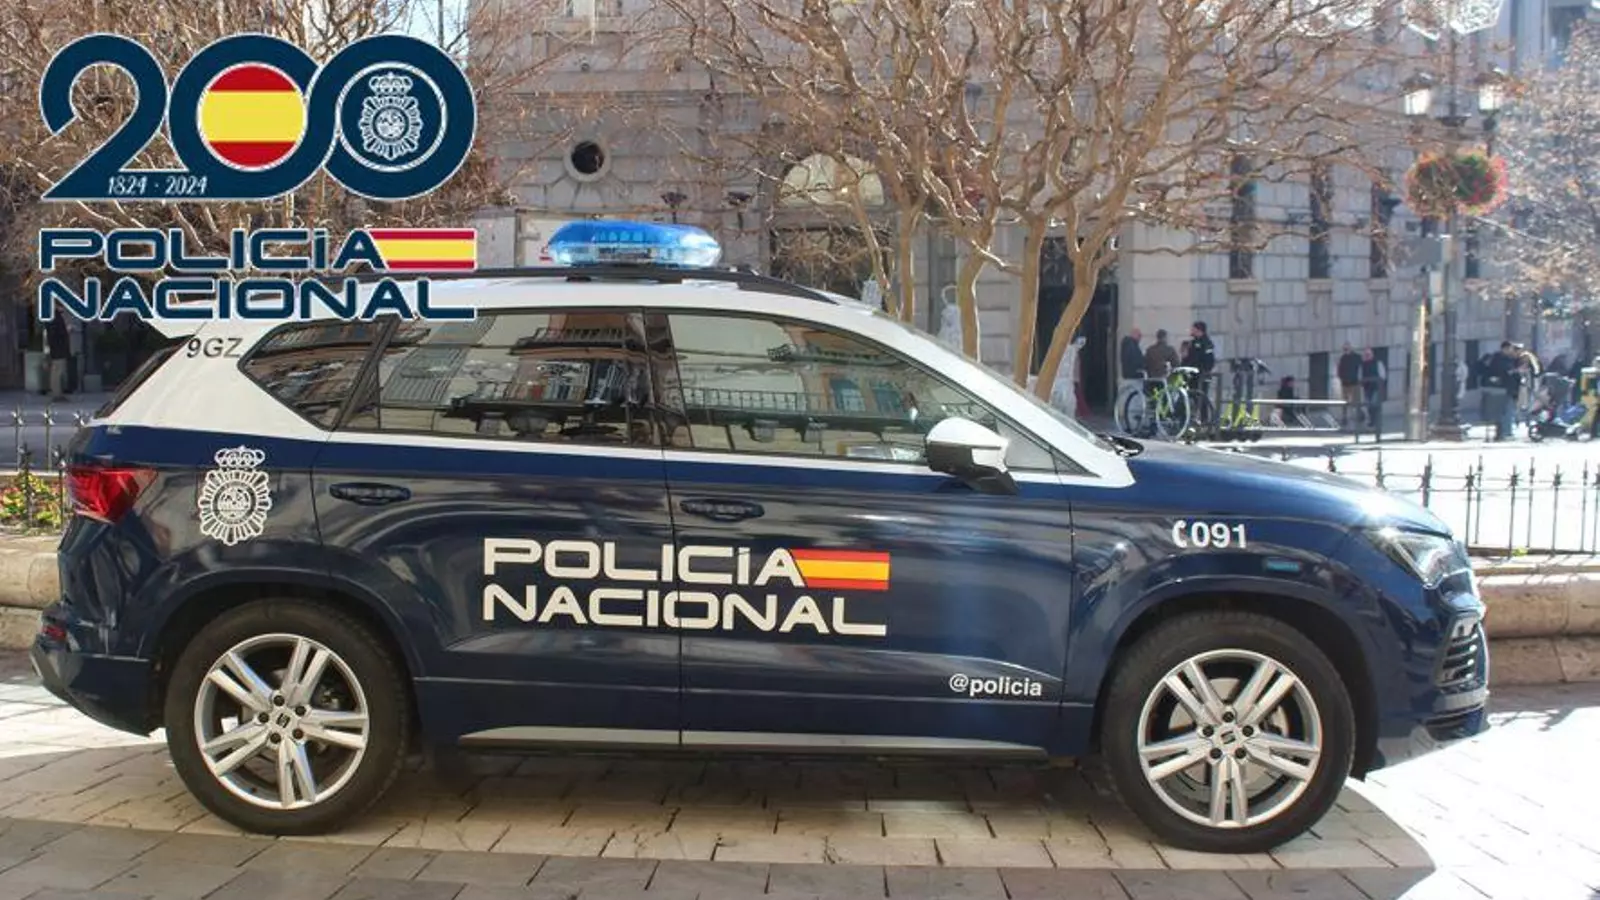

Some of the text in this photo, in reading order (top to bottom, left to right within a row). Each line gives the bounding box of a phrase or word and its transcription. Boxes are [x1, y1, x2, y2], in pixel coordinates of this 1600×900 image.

[186, 337, 243, 358] 9GZ
[483, 584, 888, 636] NACIONAL
[949, 673, 1042, 697] @policia
